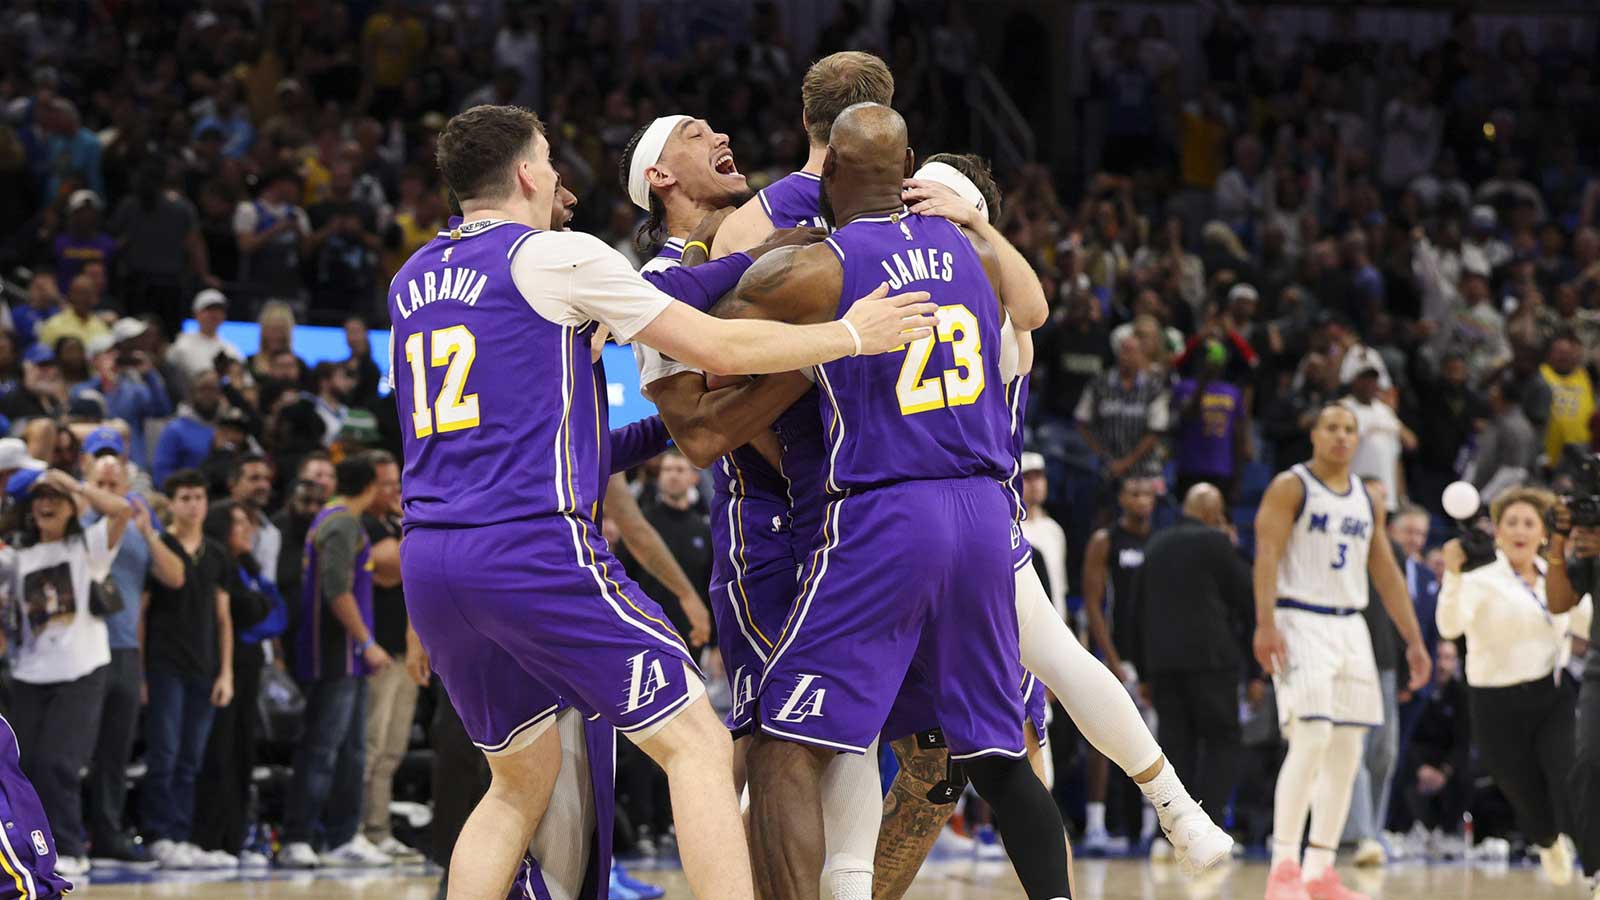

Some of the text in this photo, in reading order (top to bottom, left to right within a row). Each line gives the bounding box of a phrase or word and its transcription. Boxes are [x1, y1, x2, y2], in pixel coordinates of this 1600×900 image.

[396, 267, 488, 320] LARAVIA
[880, 248, 953, 290] JAMES
[405, 324, 481, 440] 12
[887, 303, 986, 416] 23
[1330, 543, 1348, 570] 3
[618, 649, 670, 716] LA
[770, 673, 827, 723] LA
